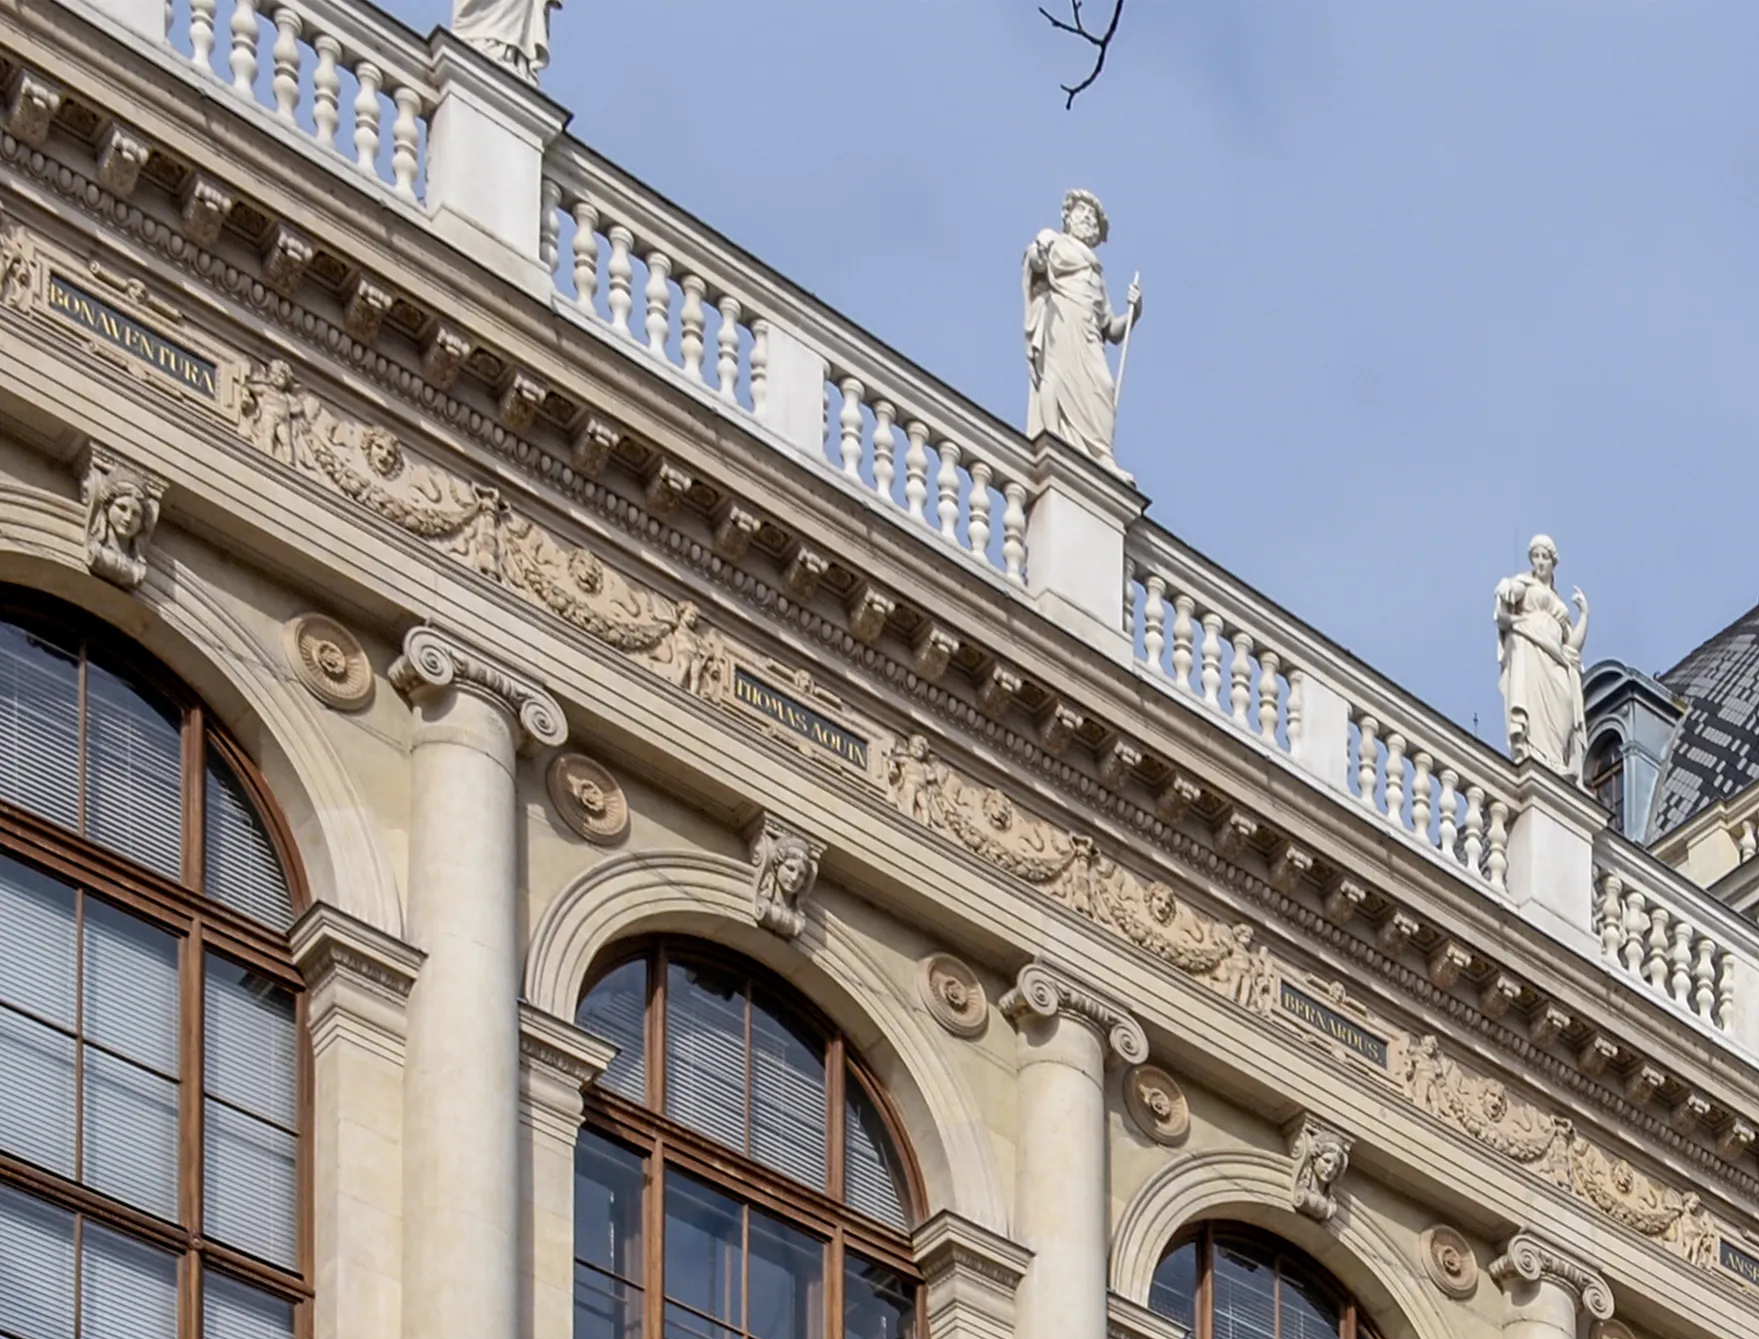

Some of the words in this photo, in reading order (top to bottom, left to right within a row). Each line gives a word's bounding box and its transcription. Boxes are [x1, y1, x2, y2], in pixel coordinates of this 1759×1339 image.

[50, 283, 214, 394] BONAVENTURA
[737, 679, 807, 732] THOMAS
[812, 721, 866, 769] AQUIN
